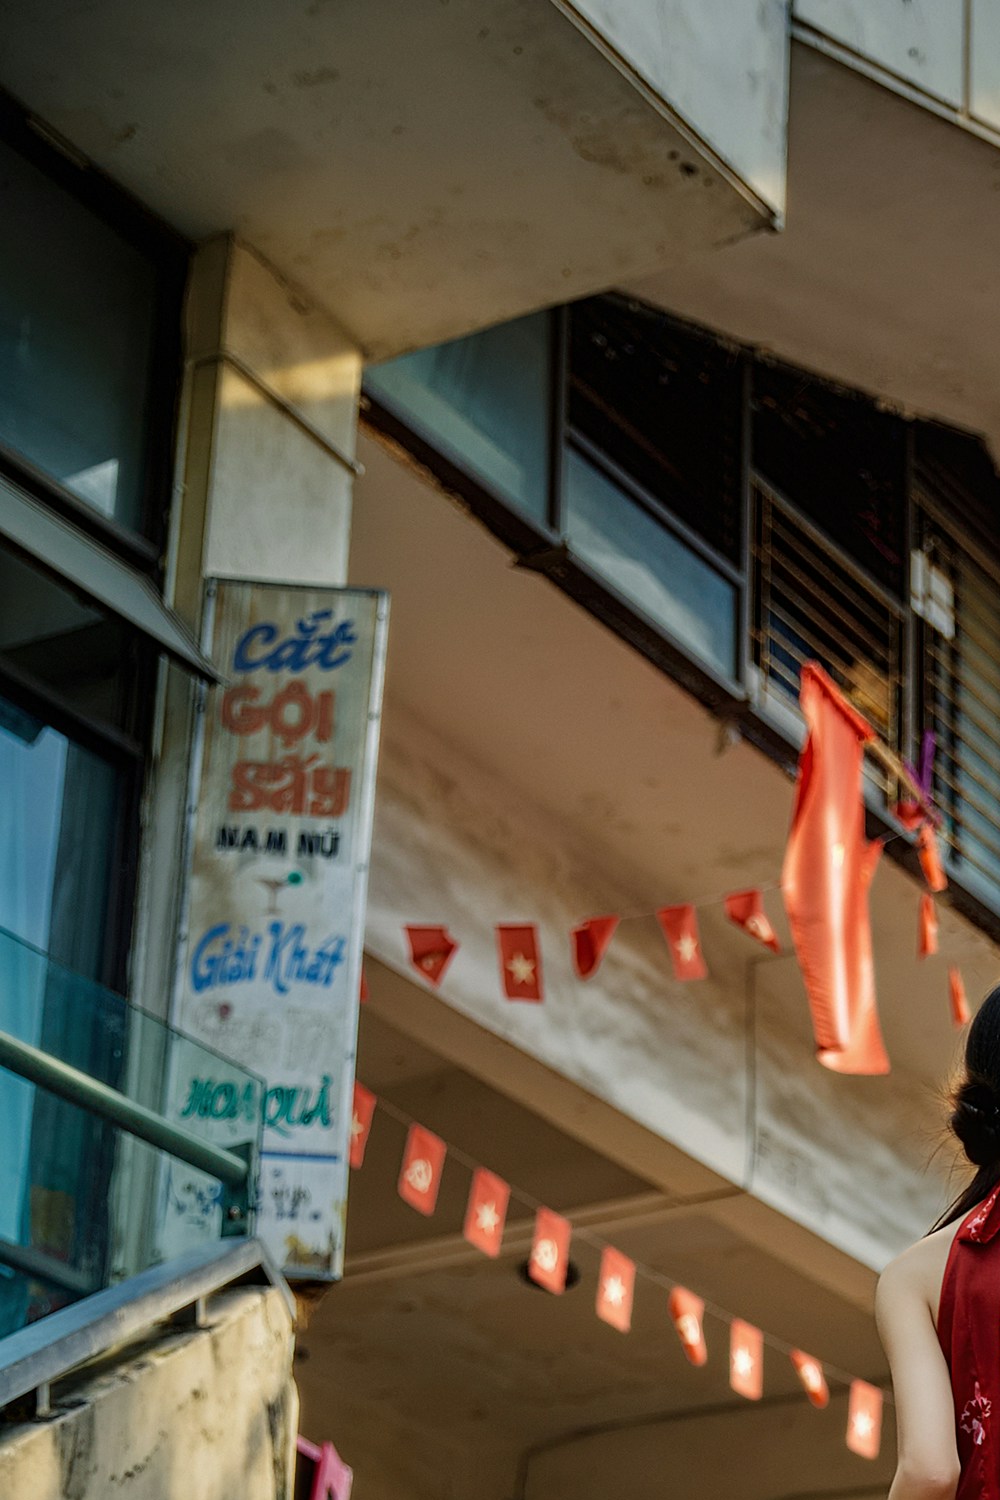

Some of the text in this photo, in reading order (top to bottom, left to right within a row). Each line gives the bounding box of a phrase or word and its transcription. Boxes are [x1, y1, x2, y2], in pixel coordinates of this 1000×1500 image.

[233, 609, 357, 672] Cắt
[216, 826, 287, 856] NAM
[191, 919, 347, 996] Giải Khát
